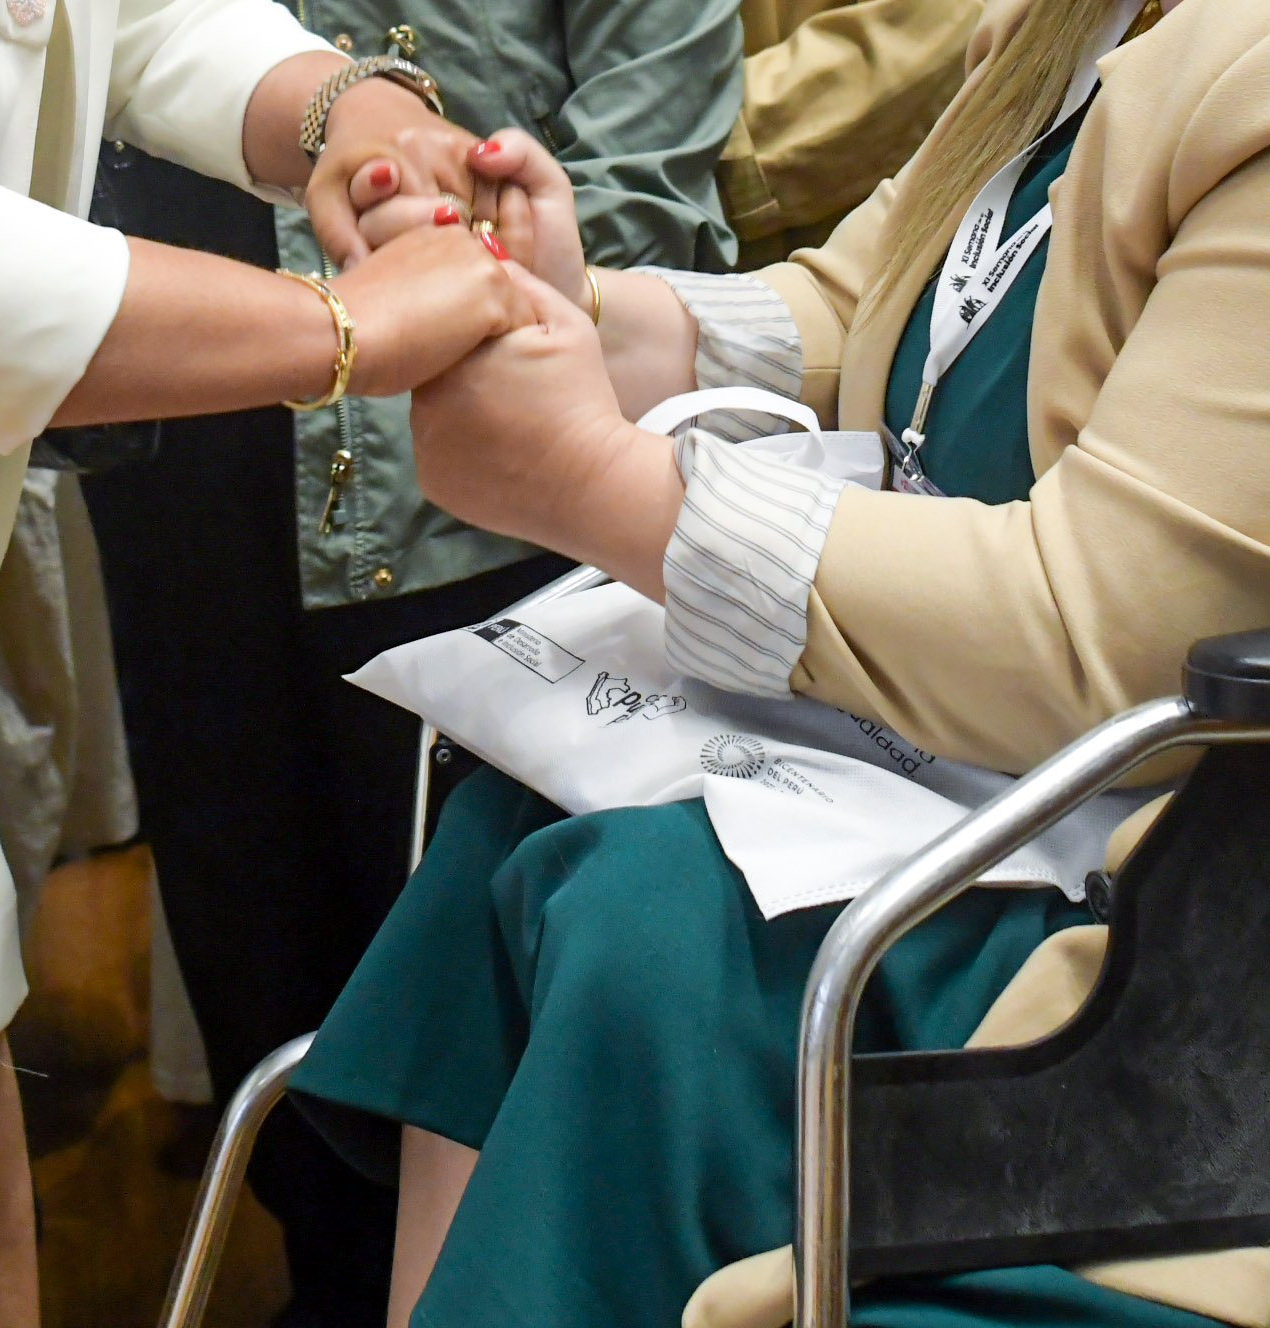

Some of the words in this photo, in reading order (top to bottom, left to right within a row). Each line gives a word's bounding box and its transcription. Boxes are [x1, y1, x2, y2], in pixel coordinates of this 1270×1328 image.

[964, 223, 980, 256] Semana
[969, 233, 986, 269] Inclusión
[981, 208, 994, 234] Social
[987, 250, 1018, 293] Inclusión
[988, 241, 1017, 277] Semana
[767, 767, 781, 783] DEL
[773, 758, 834, 803] BICENTENARIO
